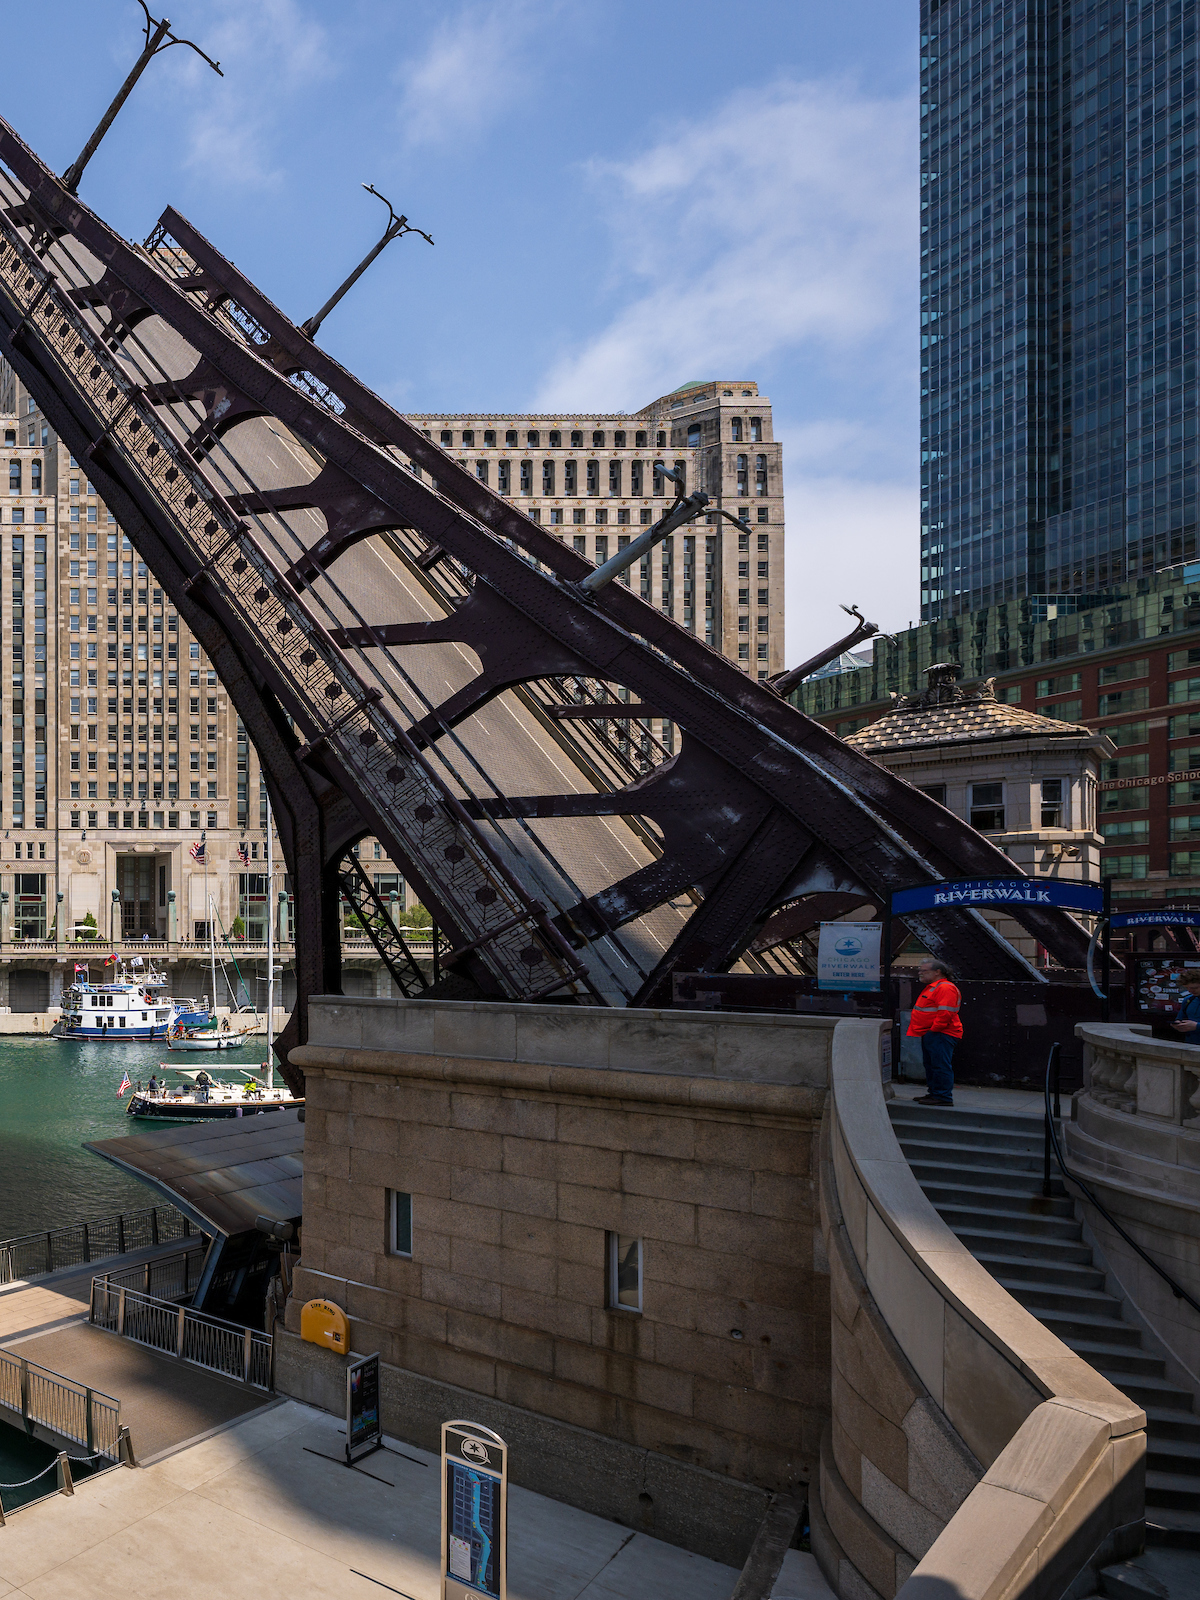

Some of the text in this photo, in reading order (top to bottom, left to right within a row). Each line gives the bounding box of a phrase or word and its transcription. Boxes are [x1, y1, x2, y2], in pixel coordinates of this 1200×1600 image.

[1097, 781, 1115, 791] The
[1117, 775, 1165, 788] Chicago
[952, 881, 1031, 890] CHICAGO
[933, 888, 1051, 905] RIVERWALK
[1126, 916, 1195, 925] RIVERWALK
